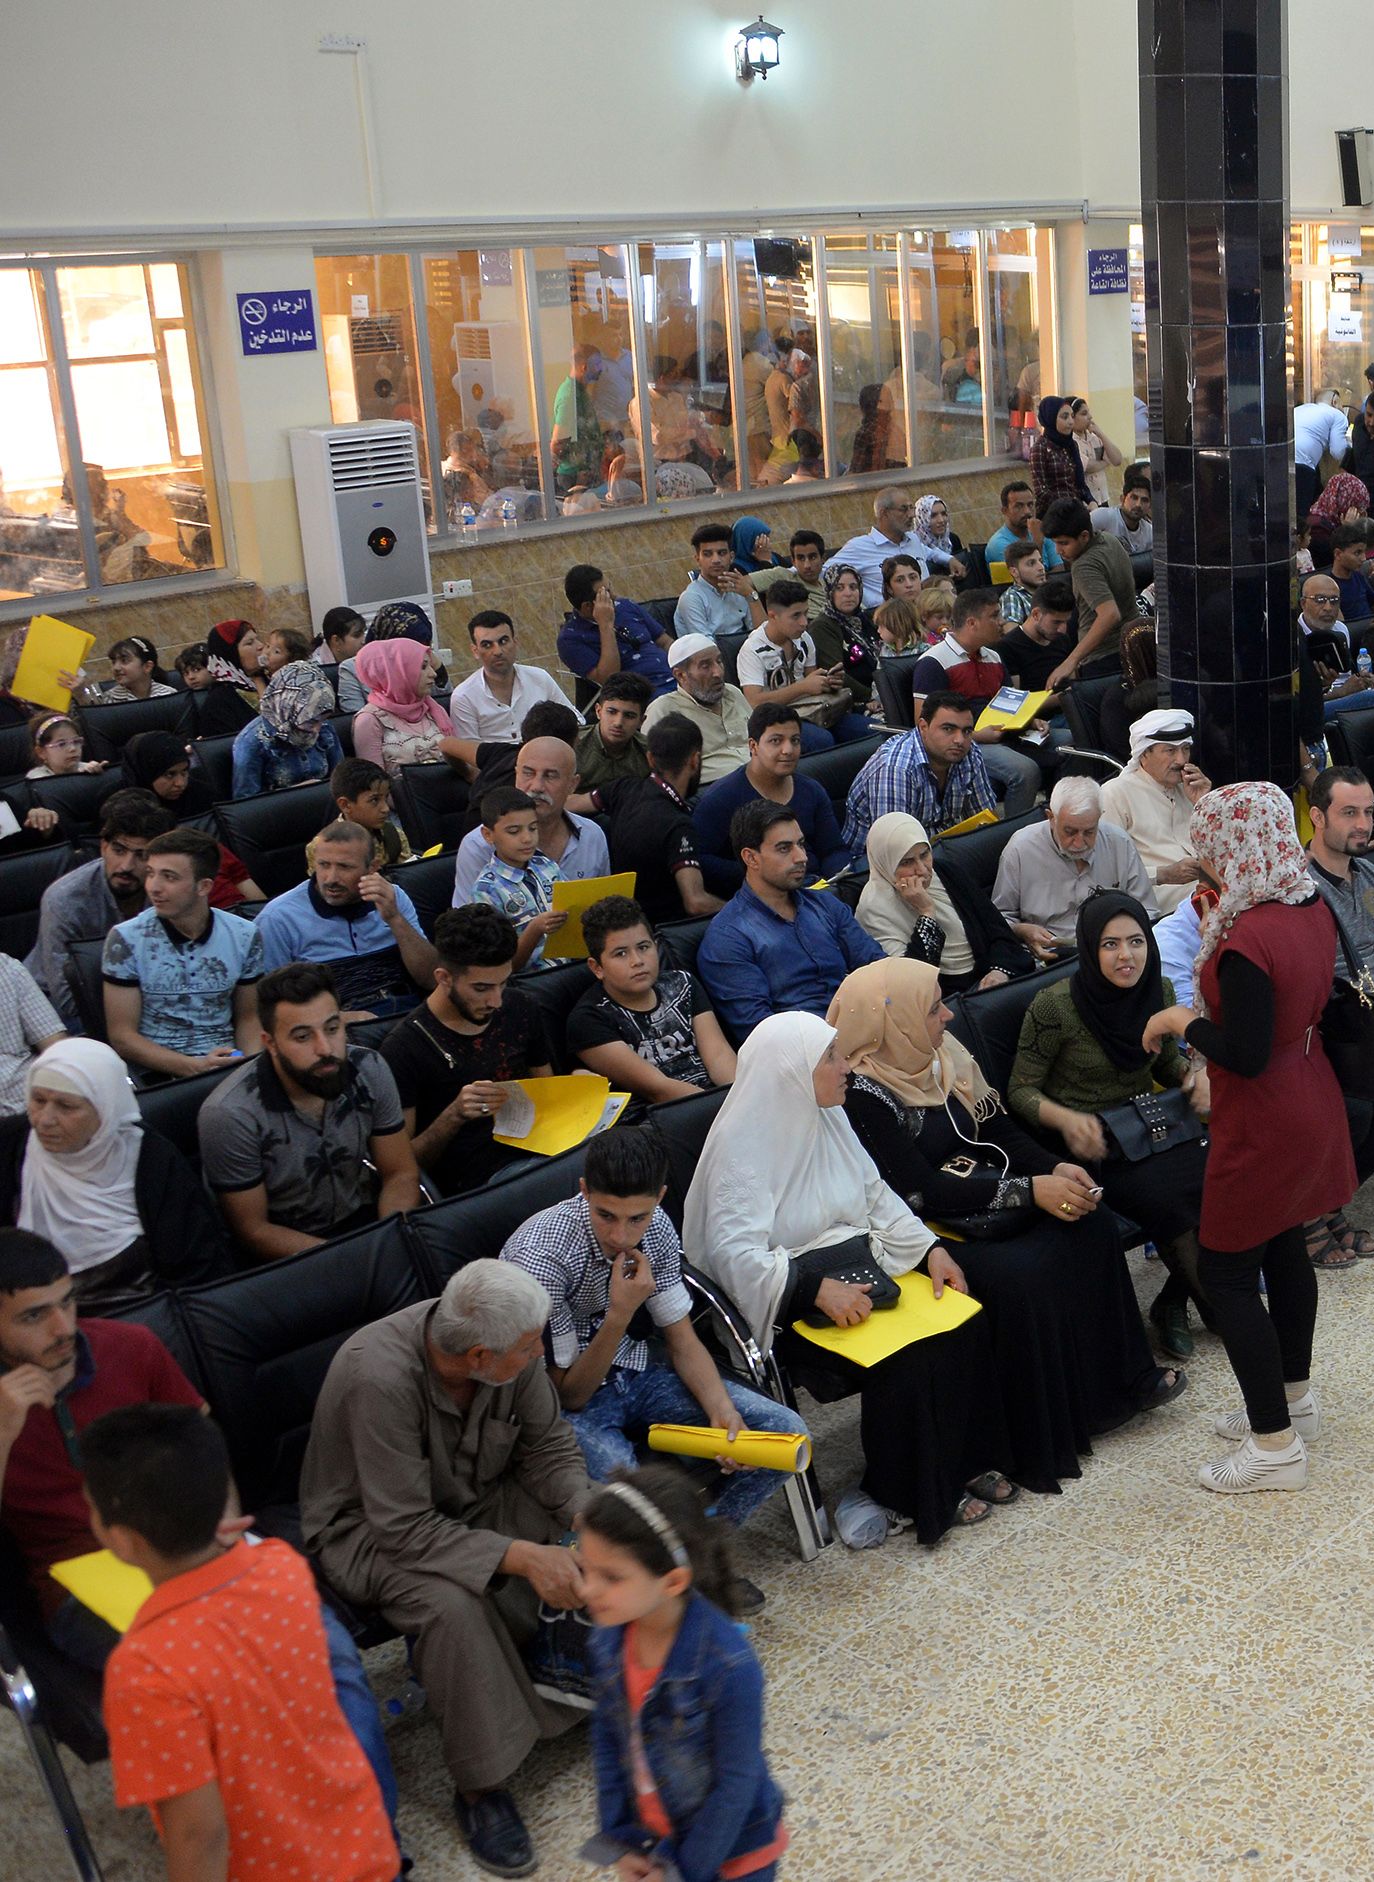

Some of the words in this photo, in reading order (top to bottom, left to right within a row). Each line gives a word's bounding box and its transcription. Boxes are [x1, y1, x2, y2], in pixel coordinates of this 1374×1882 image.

[1099, 252, 1118, 262] الرجاء
[1091, 266, 1102, 277] على
[1103, 264, 1126, 274] المحافظة
[1091, 279, 1109, 289] القاعة
[1110, 278, 1127, 288] نظافة
[272, 297, 307, 315] الرجاء
[249, 328, 290, 349] التدخين
[292, 329, 313, 345] عدم
